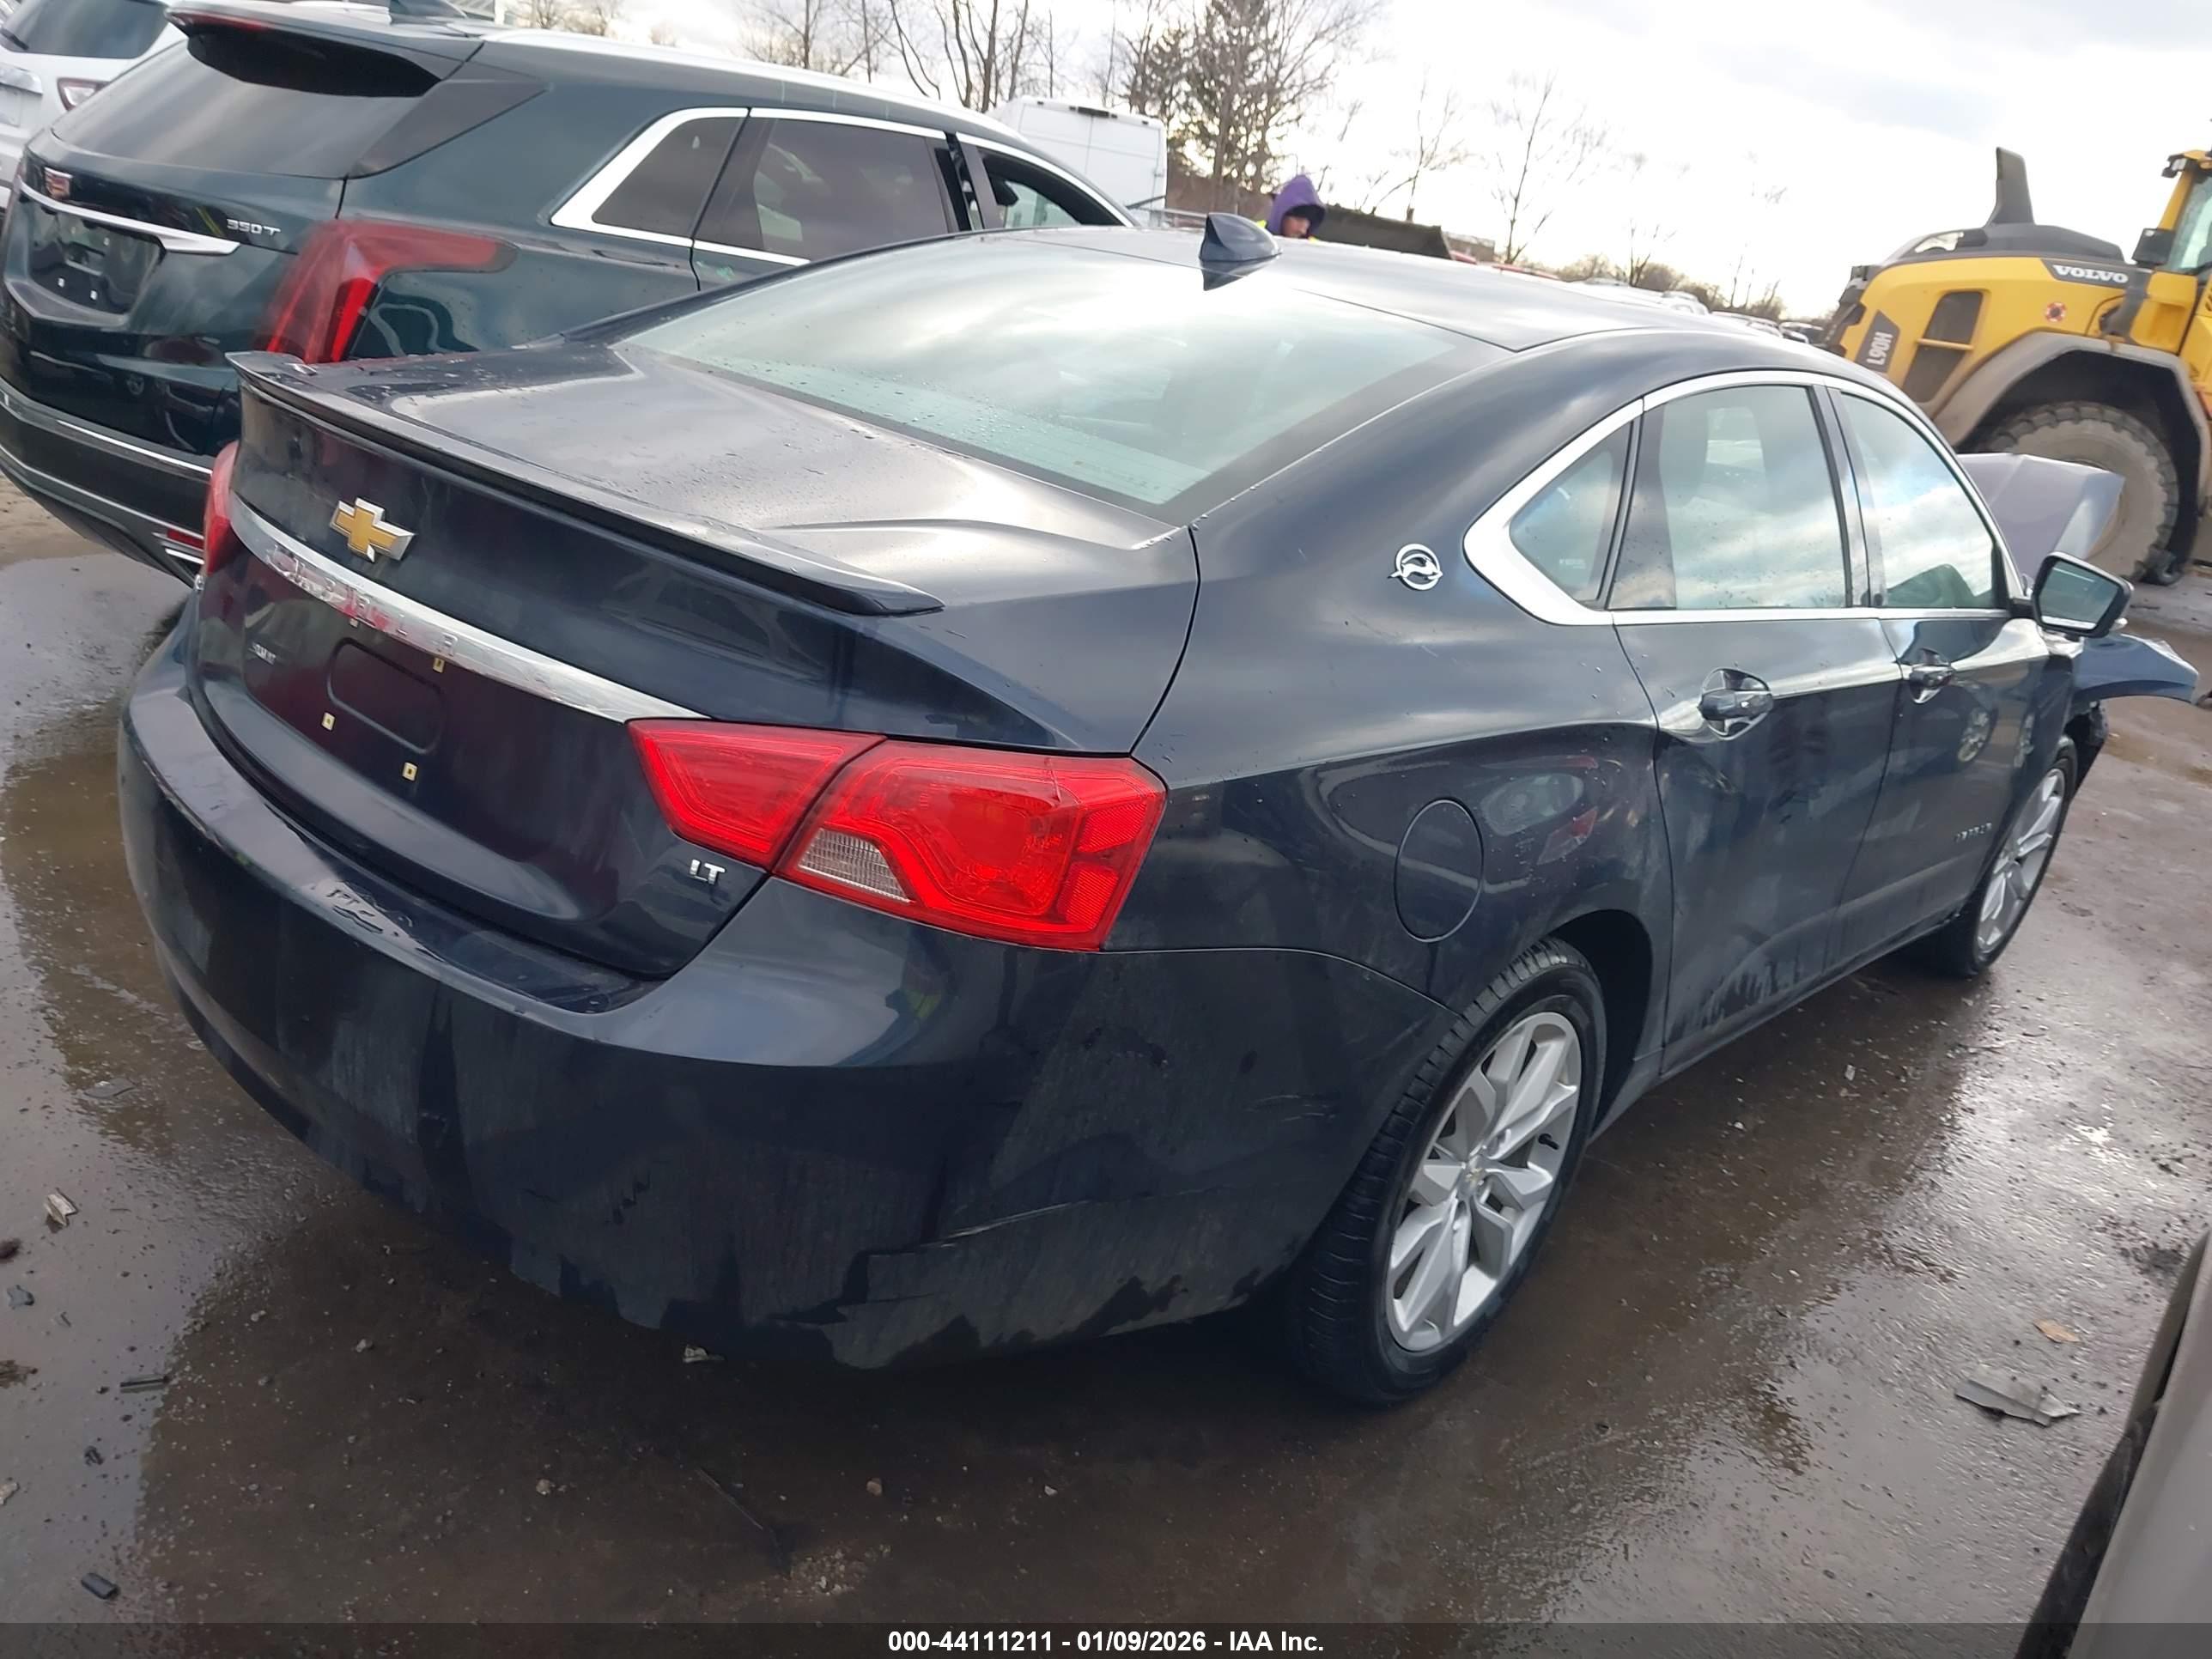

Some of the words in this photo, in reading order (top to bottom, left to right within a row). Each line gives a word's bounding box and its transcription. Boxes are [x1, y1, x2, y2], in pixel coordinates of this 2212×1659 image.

[226, 218, 282, 236] 350T
[2052, 264, 2129, 284] VOLVO
[1866, 331, 1894, 366] L90H
[690, 859, 726, 885] LT
